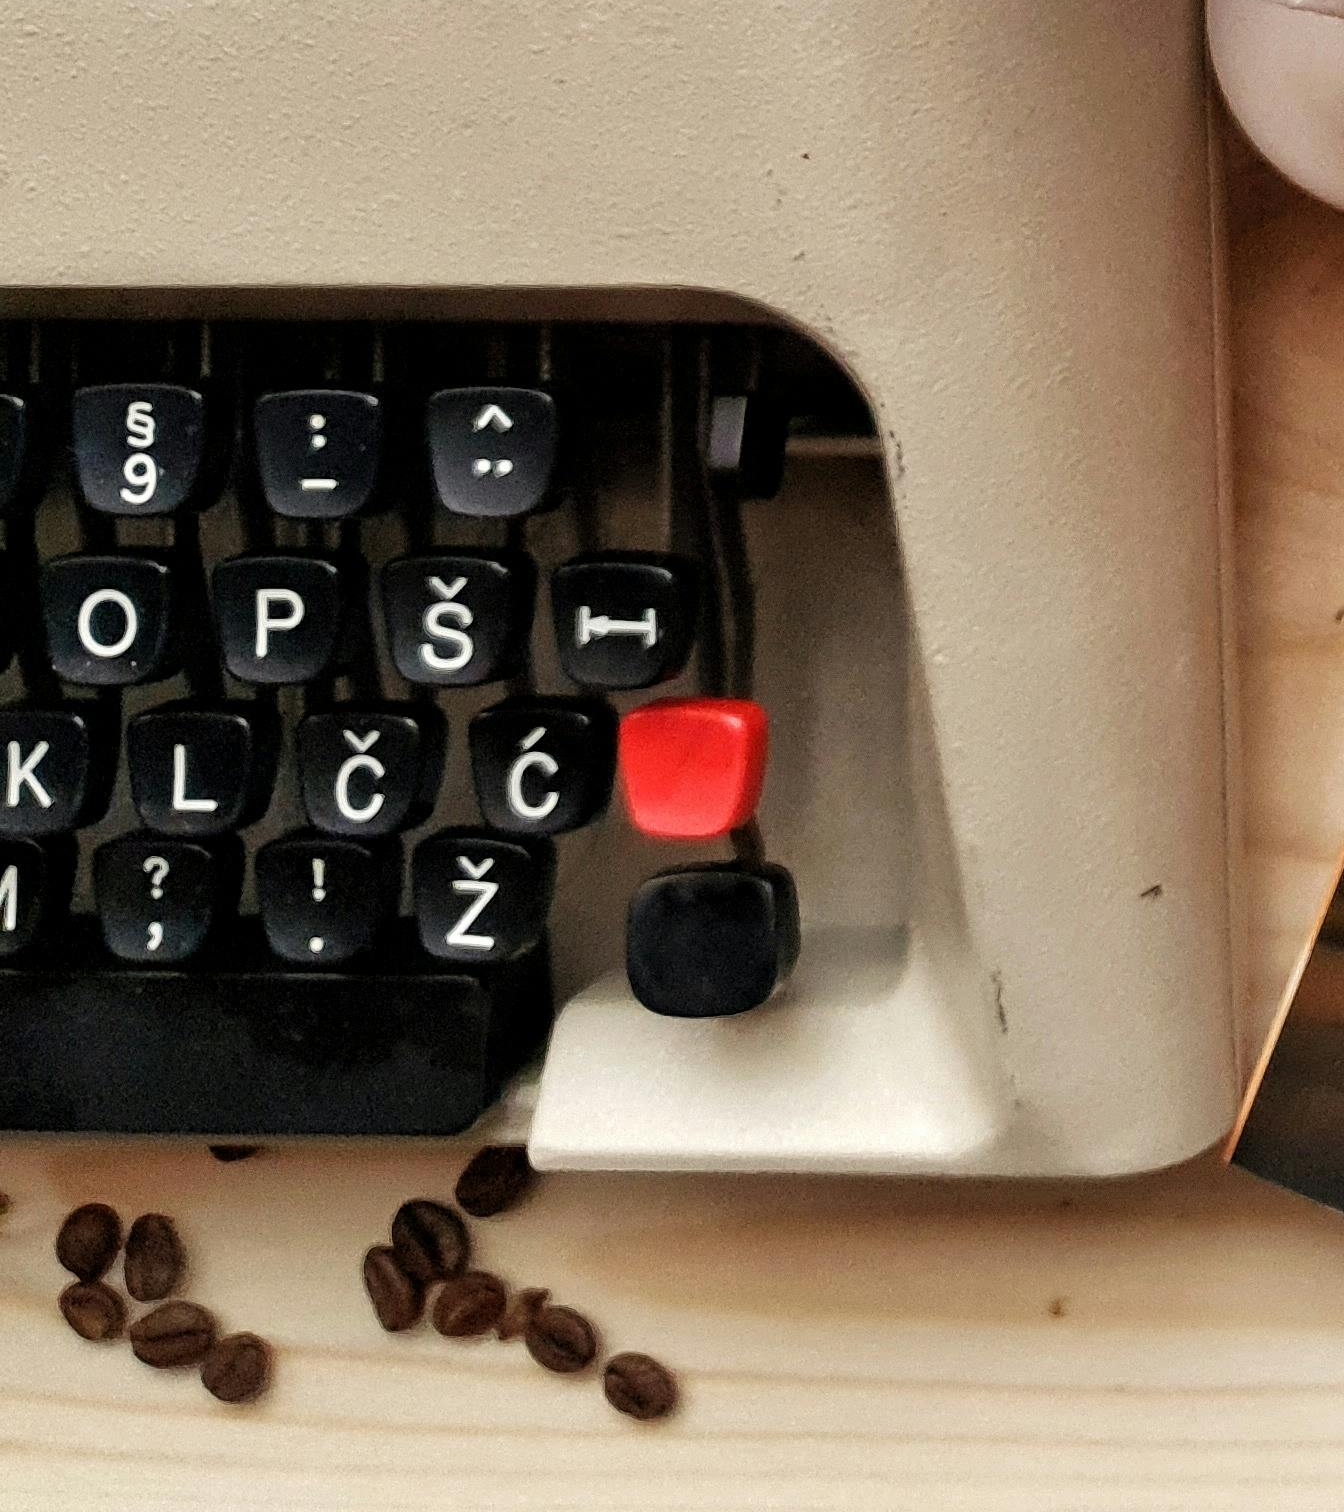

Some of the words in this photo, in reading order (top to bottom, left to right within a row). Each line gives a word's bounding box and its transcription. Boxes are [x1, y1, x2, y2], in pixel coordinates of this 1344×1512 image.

[119, 452, 157, 506] 9
[77, 588, 139, 659] O
[254, 588, 305, 659] P
[420, 576, 474, 672] Š
[7, 740, 54, 808] K
[172, 743, 219, 812] L
[335, 730, 386, 822] Č
[506, 727, 560, 820] Ć
[446, 856, 500, 951] Ž
